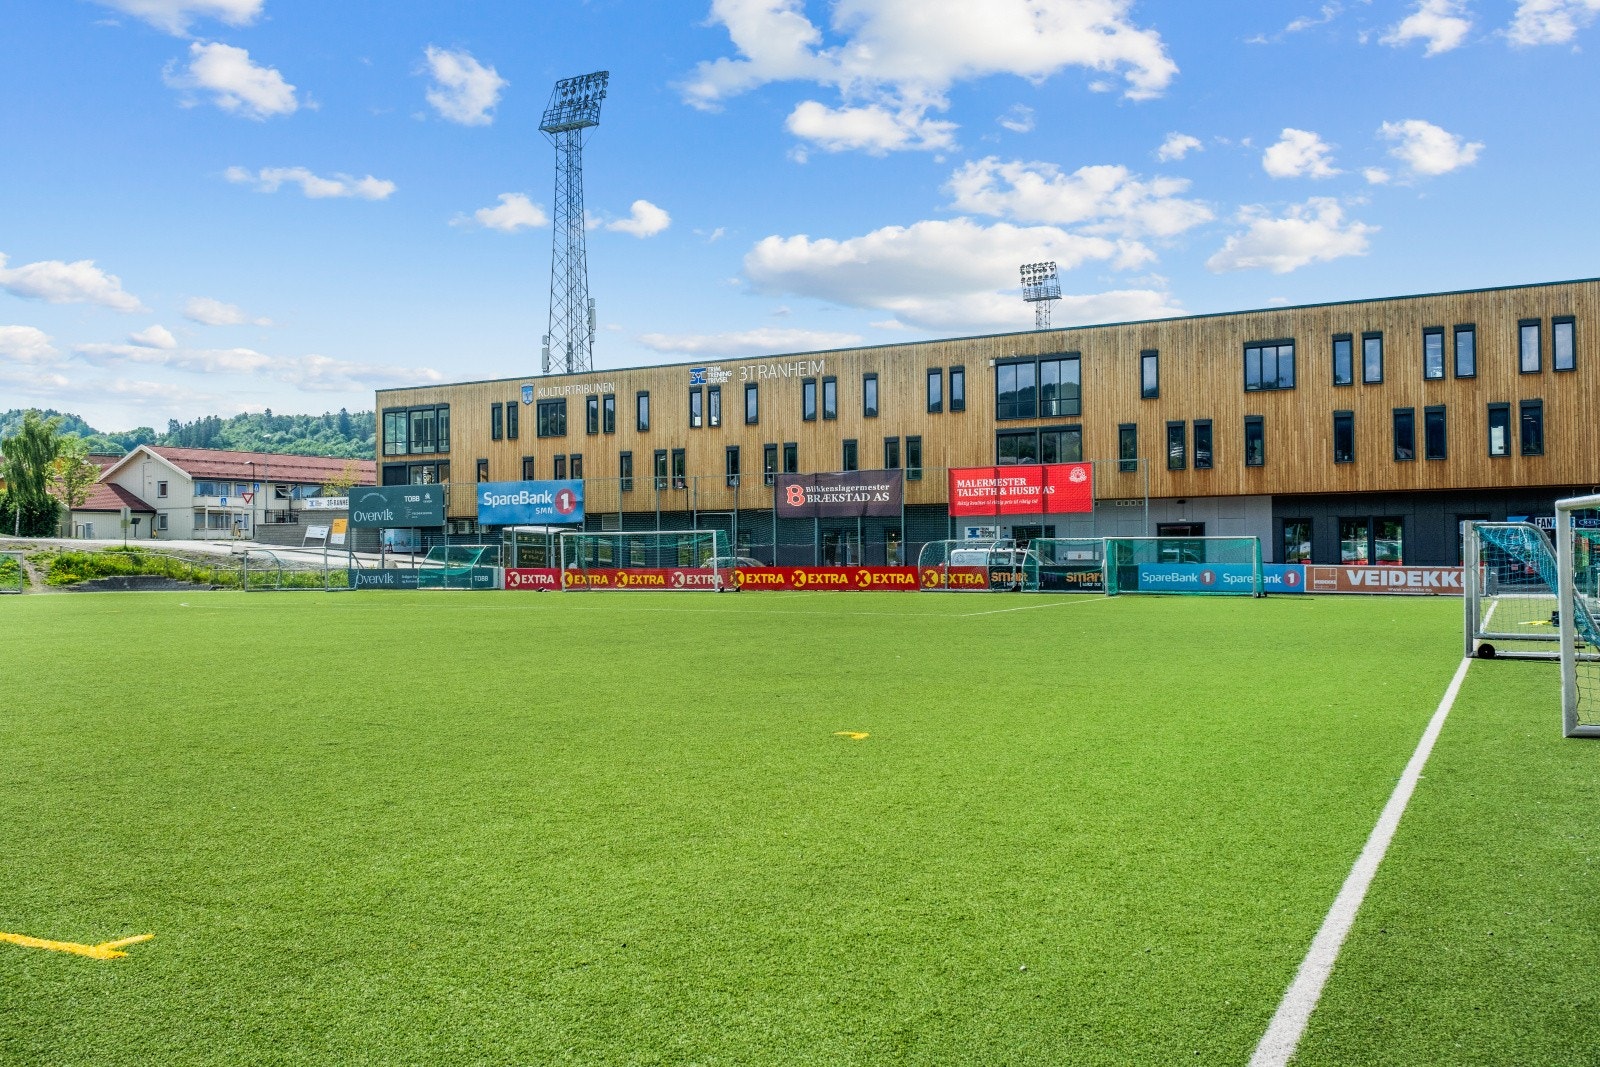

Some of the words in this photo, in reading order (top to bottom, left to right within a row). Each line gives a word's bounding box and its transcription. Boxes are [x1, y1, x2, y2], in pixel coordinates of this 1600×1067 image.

[538, 382, 615, 398] KULTURTRIBUNEN
[805, 484, 890, 493] Blikkenslagermester
[957, 478, 1027, 488] MALERMESTER
[957, 487, 997, 497] TALSETH
[999, 488, 1007, 496] &
[1009, 486, 1041, 495] HUSBY
[1042, 486, 1055, 494] AS
[483, 490, 552, 508] SpareBank
[807, 493, 870, 503] BRÆKSTAD
[873, 492, 890, 501] AS
[353, 509, 394, 523] Overvik
[535, 507, 553, 515] SMN
[356, 572, 394, 585] Overvik
[521, 574, 555, 584] EXTRA
[574, 574, 609, 585] EXTRA
[630, 574, 665, 585] EXTRA
[686, 574, 724, 585] EXTRA
[746, 573, 784, 584] EXTRA
[808, 573, 848, 584] EXTRA
[873, 573, 915, 584] EXTRA
[941, 573, 985, 584] EXTRA
[1142, 571, 1198, 583] SpareBank
[1223, 573, 1281, 585] SpareBank
[1346, 569, 1465, 588] VEIDEKK
